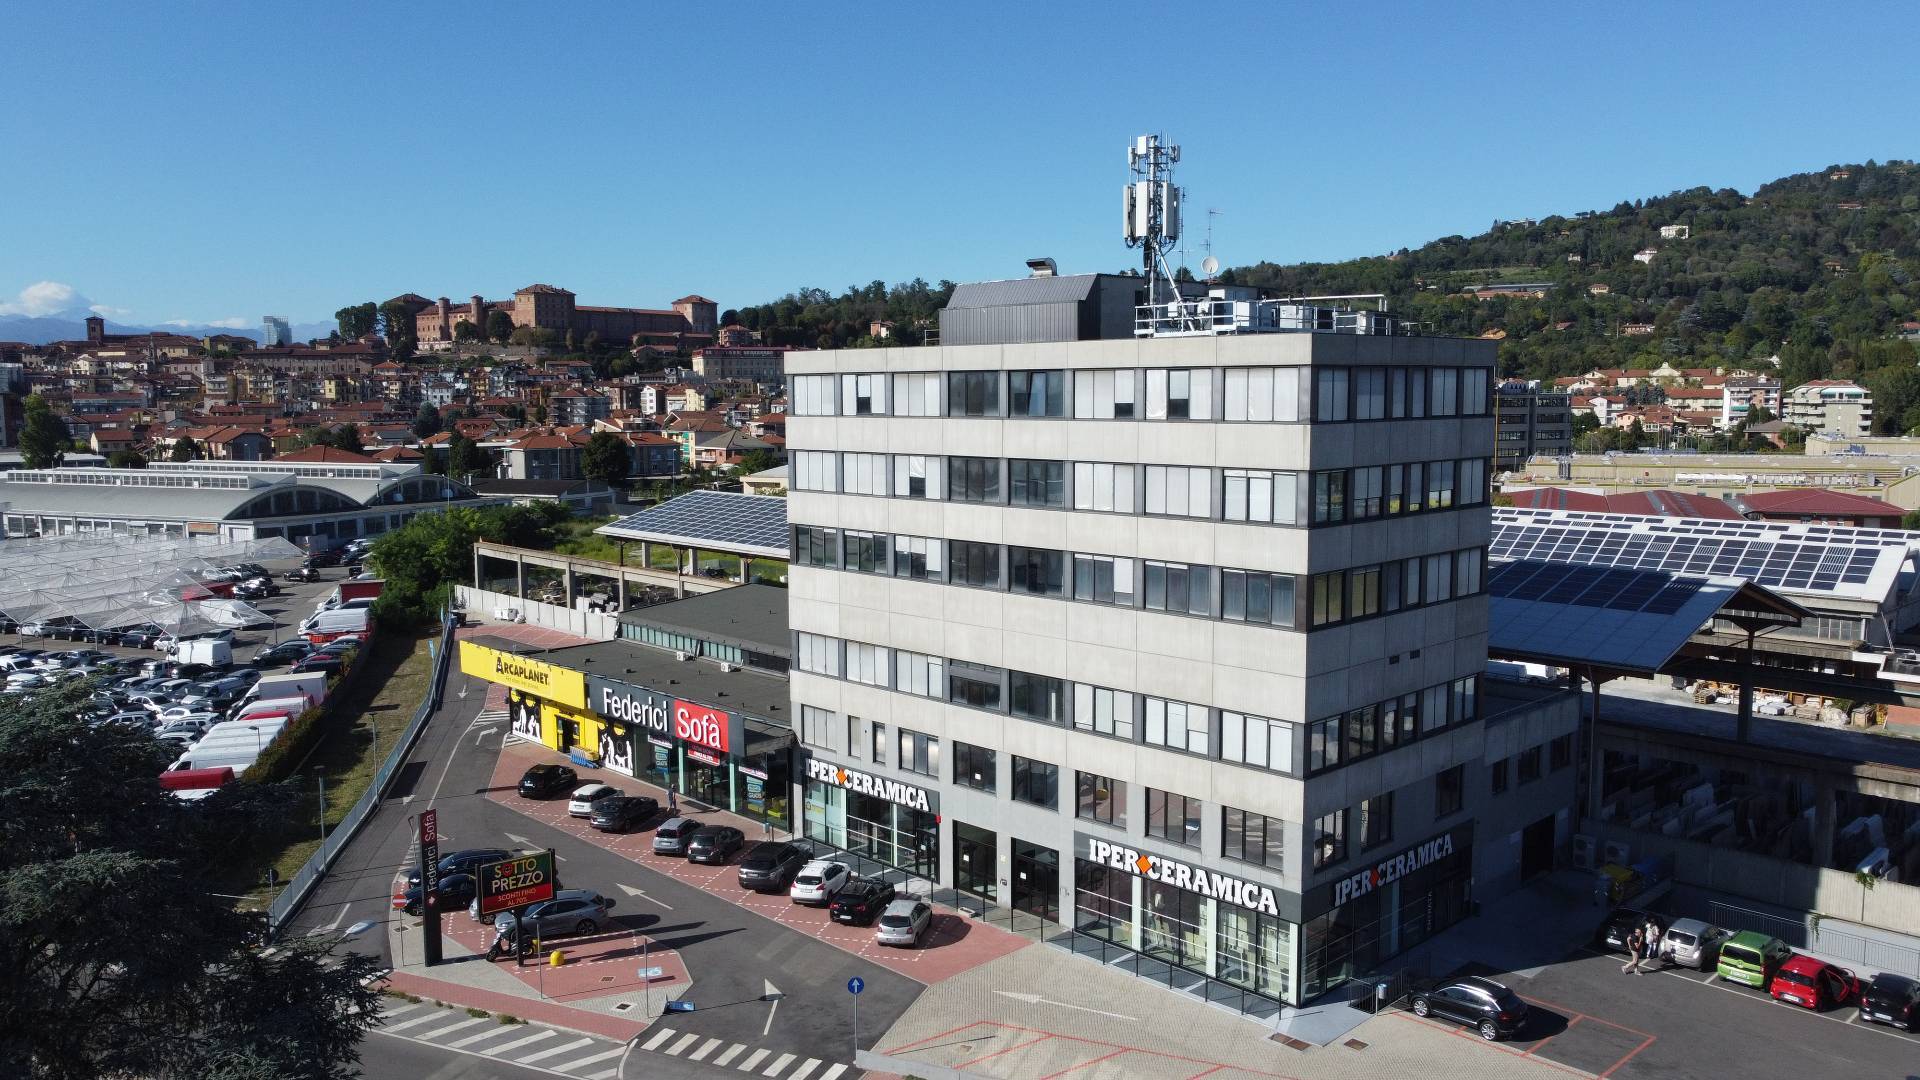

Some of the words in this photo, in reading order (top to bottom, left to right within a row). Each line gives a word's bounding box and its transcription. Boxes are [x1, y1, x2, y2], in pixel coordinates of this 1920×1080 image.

[496, 656, 549, 685] ARCAPLANET
[603, 687, 668, 732] Federici
[677, 707, 721, 748] Sofà
[426, 845, 437, 892] Federici
[492, 870, 544, 893] PREZZO
[494, 858, 537, 878] SOTTO
